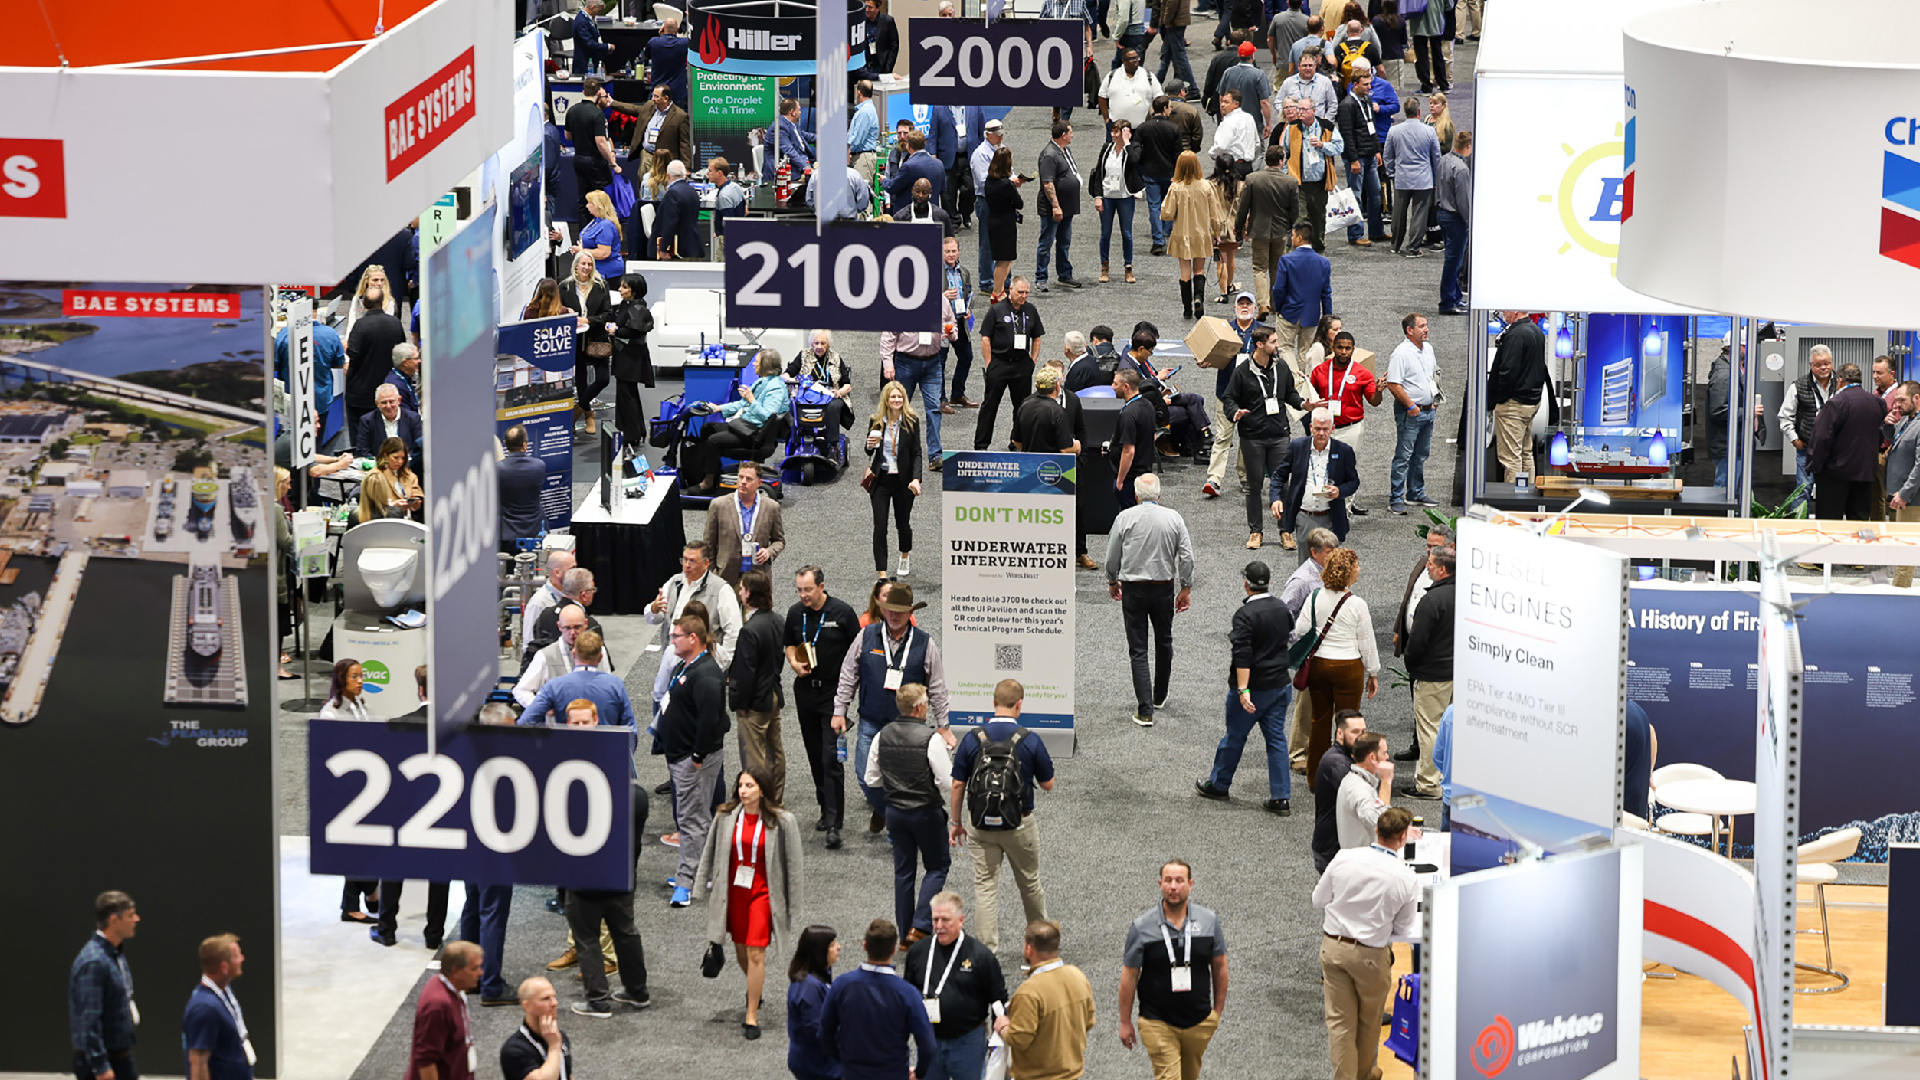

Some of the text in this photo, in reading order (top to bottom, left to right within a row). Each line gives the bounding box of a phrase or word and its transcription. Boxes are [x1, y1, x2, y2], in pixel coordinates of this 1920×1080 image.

[727, 28, 802, 51] Hiller
[919, 35, 1073, 89] 2000
[700, 82, 765, 92] Environment,
[702, 95, 762, 106] One Droplet
[708, 106, 719, 114] At
[729, 105, 757, 114] Time.
[389, 106, 416, 161] BAE
[417, 64, 472, 140] SYSTEMS
[735, 241, 930, 310] 2100
[73, 295, 230, 313] BAE SYSTEMS
[533, 325, 572, 341] SOLAR
[533, 337, 572, 354] SOLVE
[298, 336, 312, 459] EVAC
[957, 461, 1020, 471] UNDERWATER
[957, 470, 1020, 478] INTERVENTION
[955, 506, 1064, 524] DON'T MISS
[433, 450, 497, 601] 2200
[951, 540, 1067, 555] UNDERWATER
[951, 555, 1067, 569] INTERVENTION
[1471, 547, 1551, 588] DIESEL
[951, 594, 970, 602] Head
[972, 595, 980, 603] to
[981, 595, 1000, 603] aisle
[1001, 596, 1020, 604] 3700
[1031, 597, 1053, 605] check
[1470, 582, 1573, 629] ENGINES
[987, 606, 1018, 614] Pavilion
[1019, 606, 1034, 614] and
[953, 624, 1064, 635] Technical Program Schedule.
[1012, 616, 1023, 624] for
[1040, 617, 1064, 626] year's
[1641, 609, 1706, 634] History
[1710, 610, 1729, 631] of
[1468, 635, 1554, 672] Simply Clean
[1467, 678, 1486, 695] EPA
[1488, 684, 1504, 700] Tier
[1537, 698, 1555, 713] Tier
[169, 720, 200, 729] THE
[1466, 699, 1579, 738] compliance without SCR
[171, 729, 248, 738] PEARLSON
[1466, 715, 1528, 742] aftertreatment
[196, 738, 249, 747] GROUP
[325, 749, 613, 857] 2200
[1518, 1012, 1604, 1052] Wabtec
[1517, 1038, 1590, 1067] CORPORATION
